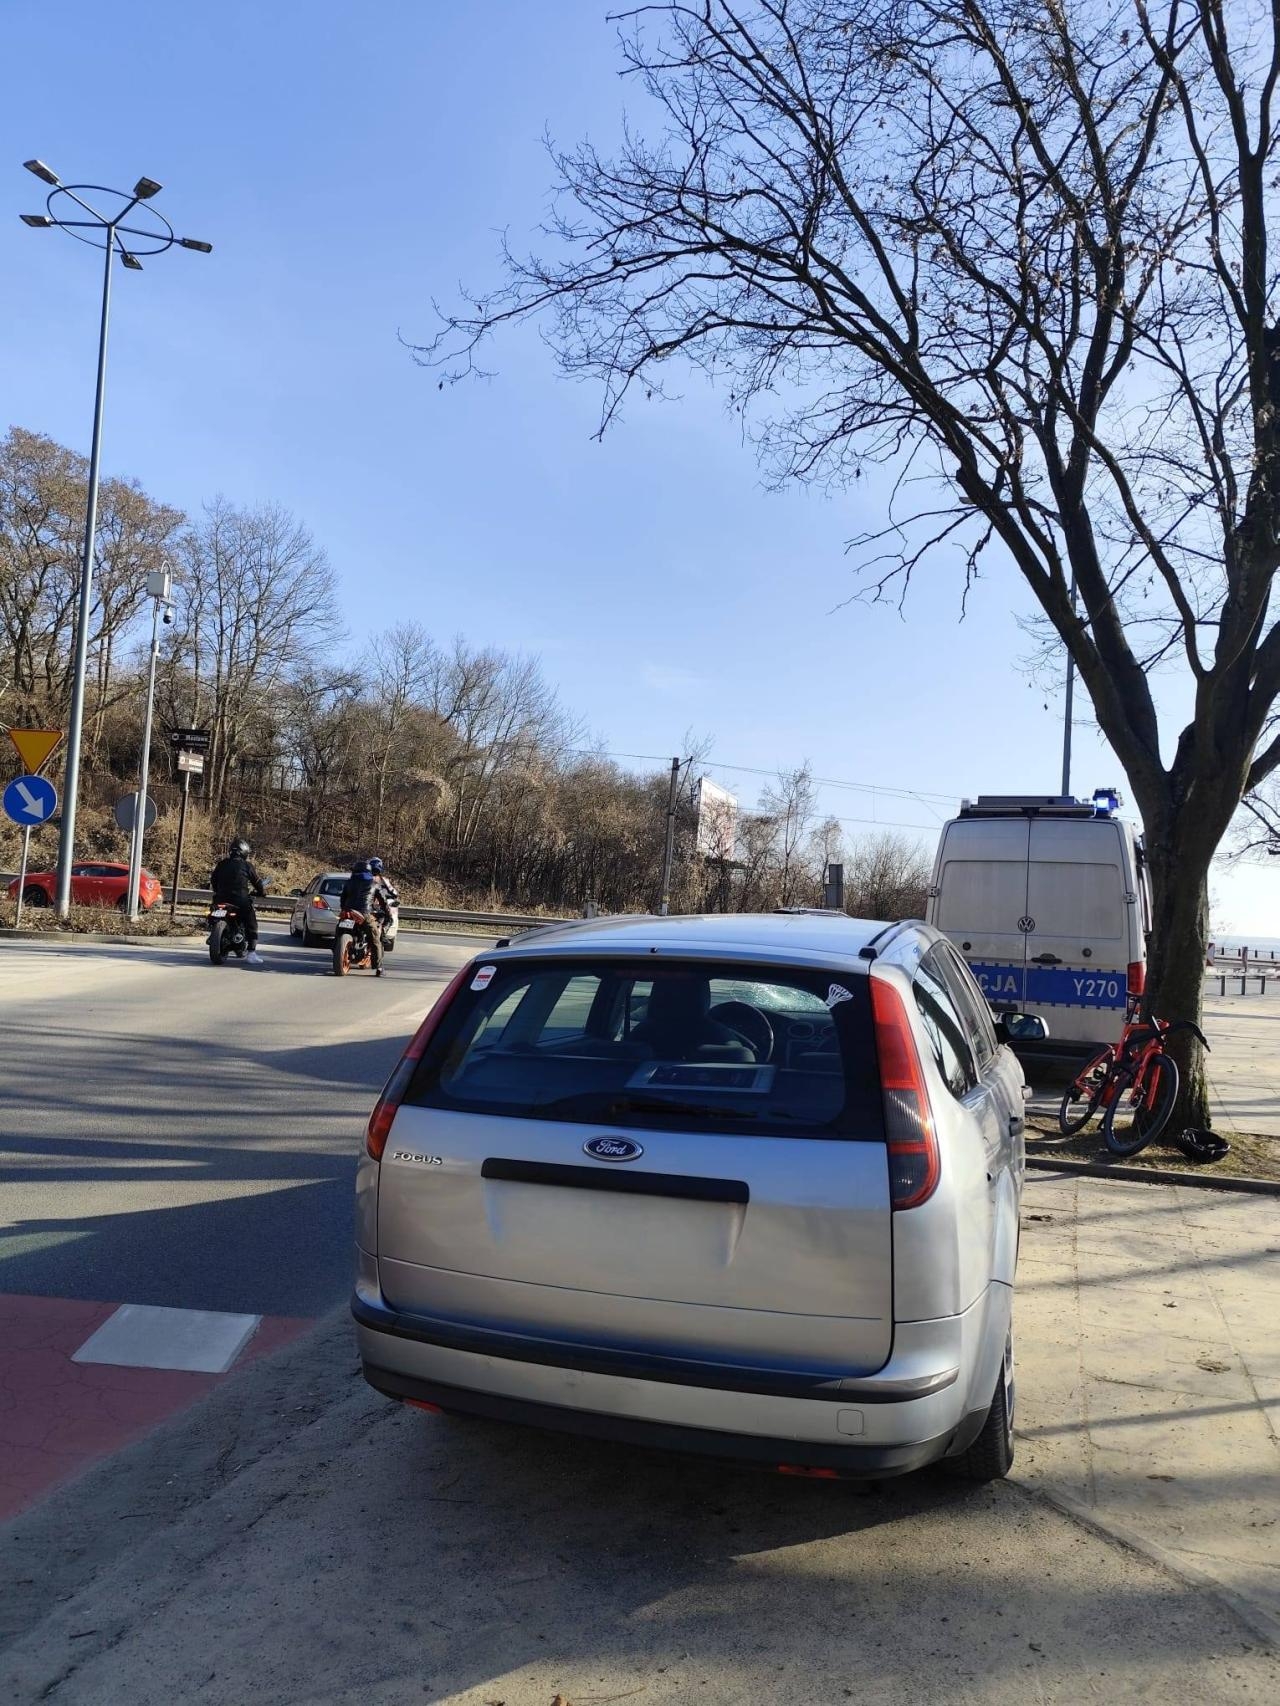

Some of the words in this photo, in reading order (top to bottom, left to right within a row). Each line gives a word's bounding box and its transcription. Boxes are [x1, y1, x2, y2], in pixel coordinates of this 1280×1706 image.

[975, 973, 1018, 993] CJA
[1073, 978, 1118, 998] Y270
[596, 1139, 627, 1155] Ford
[392, 1151, 443, 1166] FOCUS
